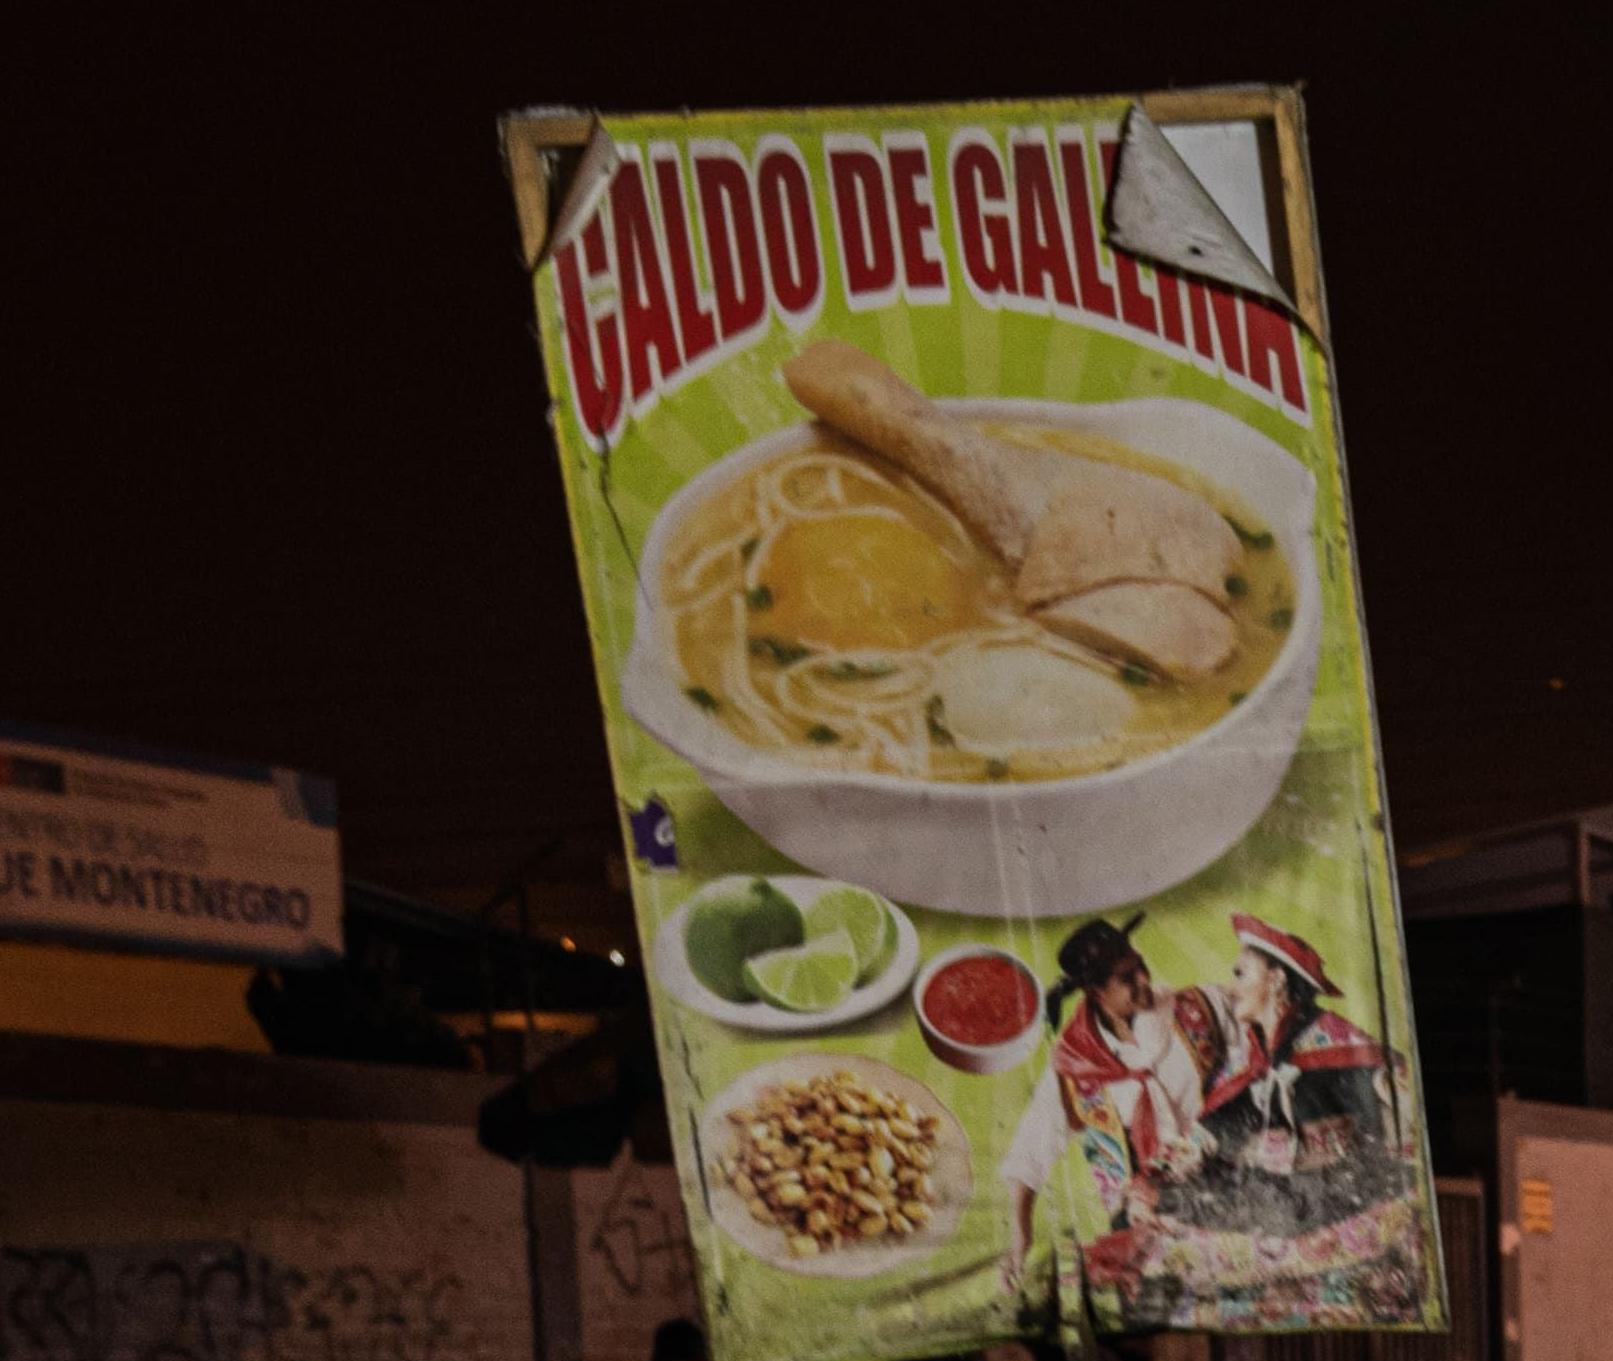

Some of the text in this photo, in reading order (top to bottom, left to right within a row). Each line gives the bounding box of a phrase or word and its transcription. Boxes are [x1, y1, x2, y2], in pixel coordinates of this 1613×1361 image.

[552, 140, 822, 443] CALDO
[829, 135, 948, 308] DE
[48, 853, 312, 930] MONTENEGRO
